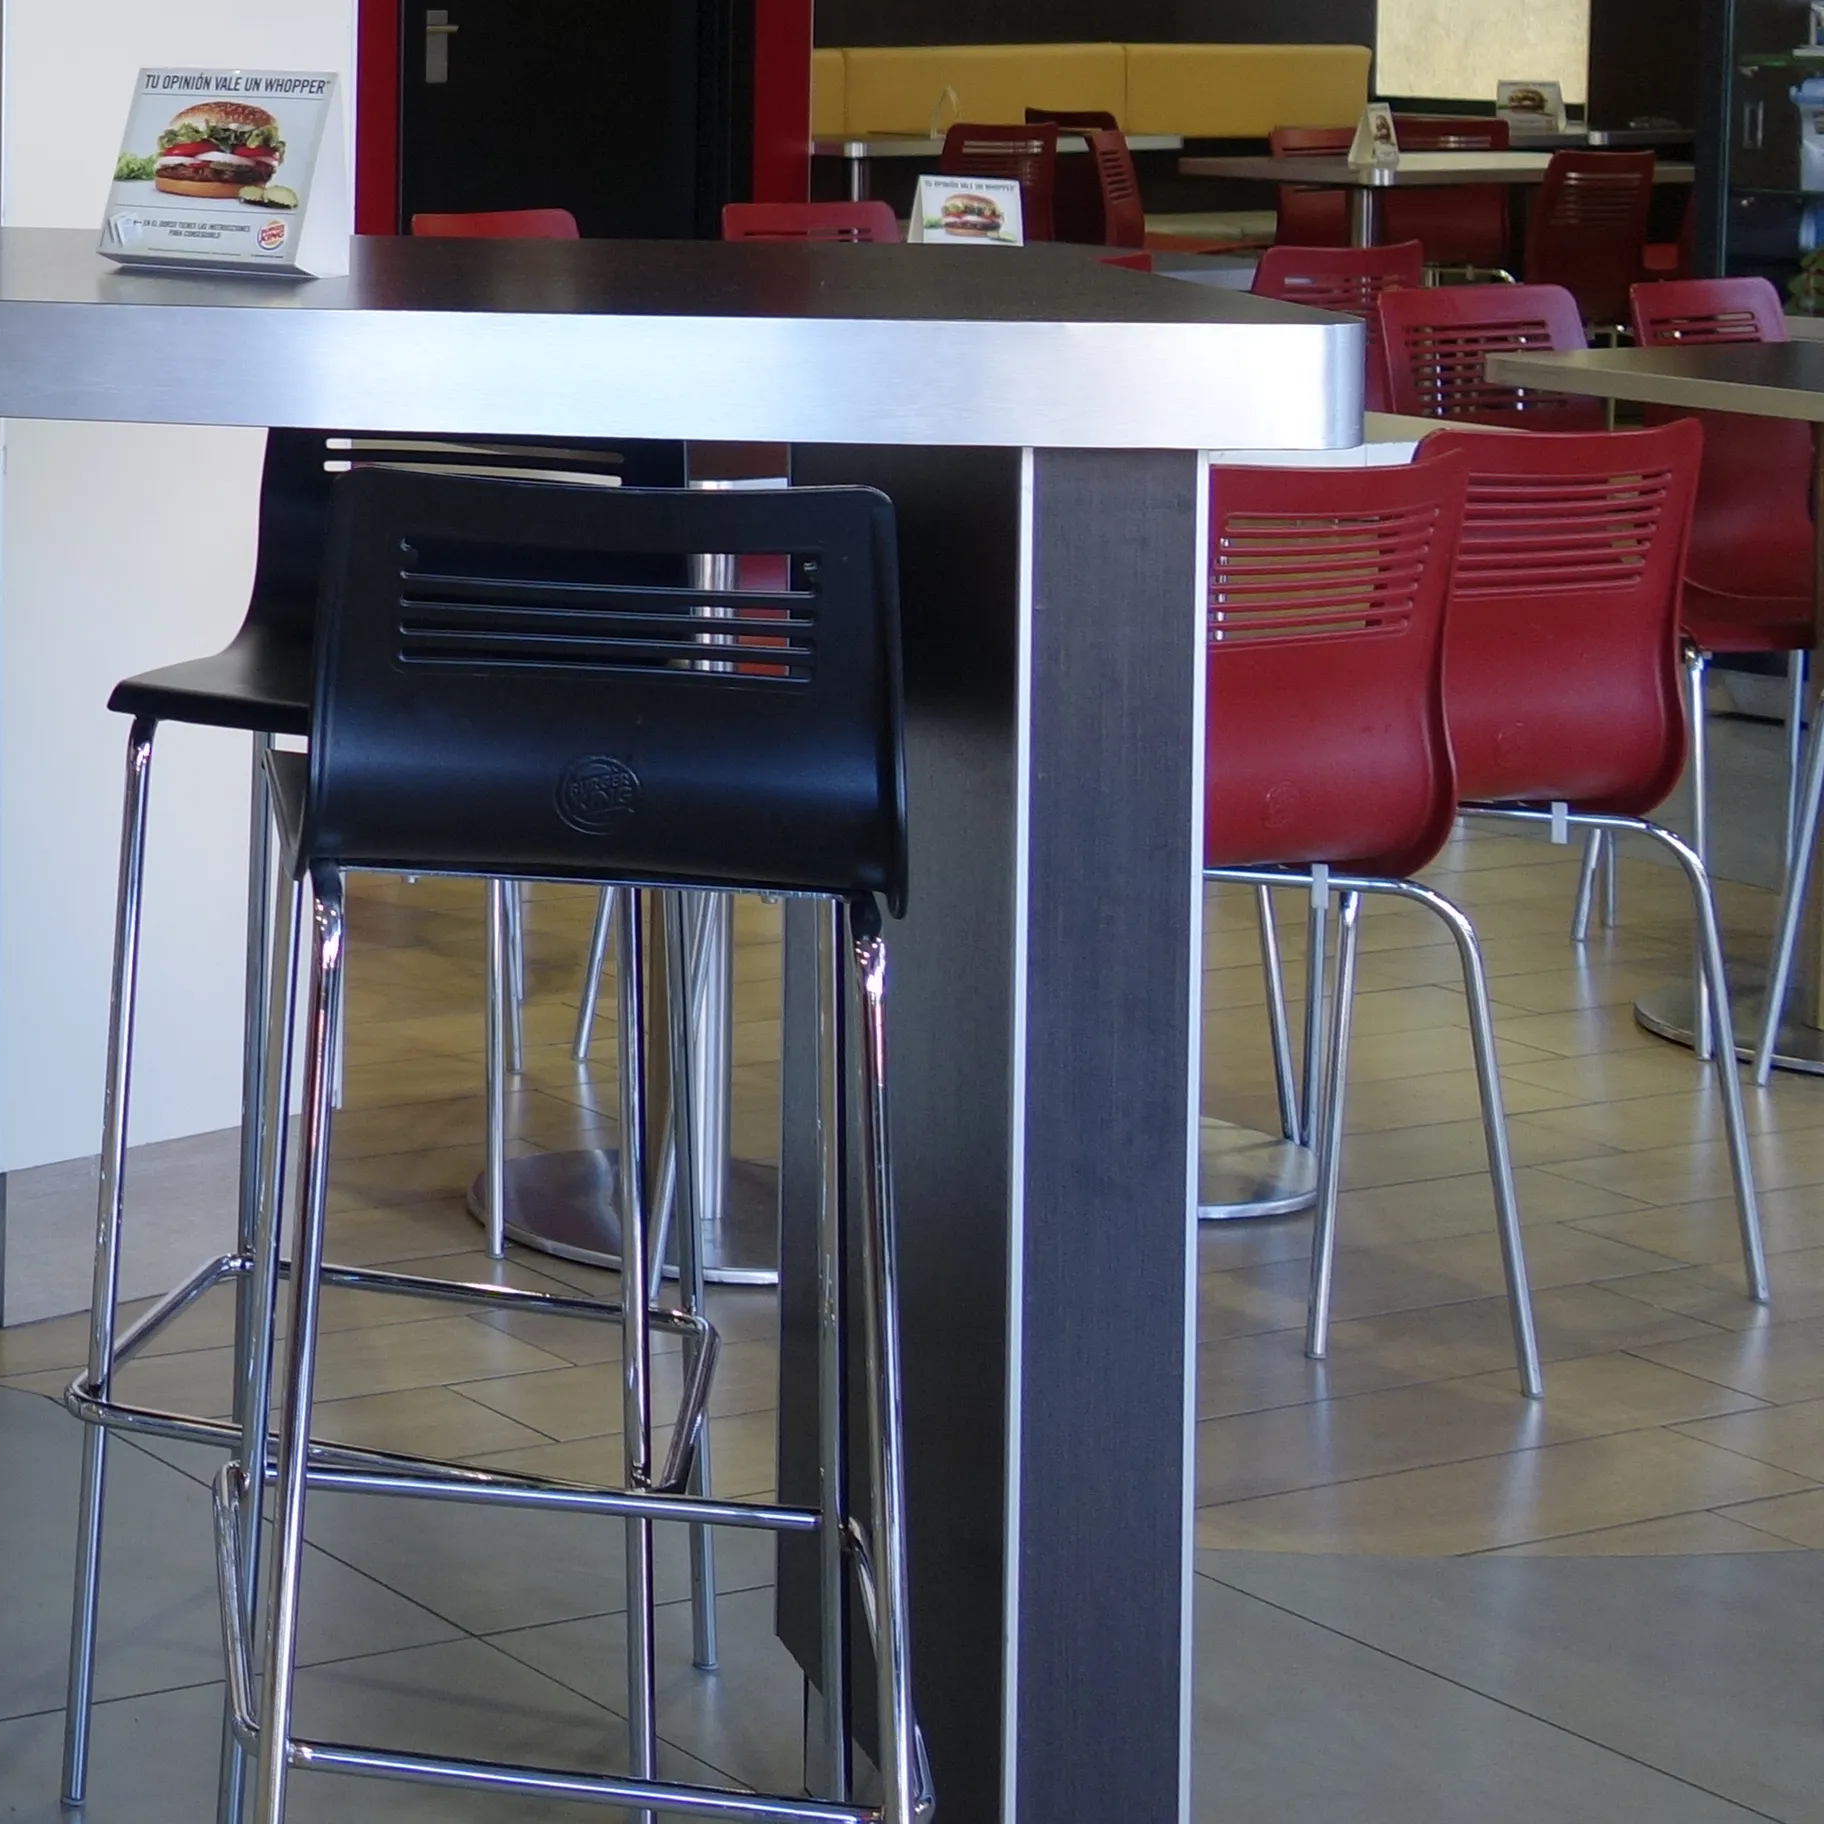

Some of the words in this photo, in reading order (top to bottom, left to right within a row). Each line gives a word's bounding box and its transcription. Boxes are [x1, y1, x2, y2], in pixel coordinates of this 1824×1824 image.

[144, 74, 160, 88] TU
[162, 73, 212, 90] OPINIÓN
[214, 76, 243, 91] VALE
[244, 77, 263, 91] UN
[264, 77, 326, 94] WHOPPER
[261, 229, 285, 241] KING
